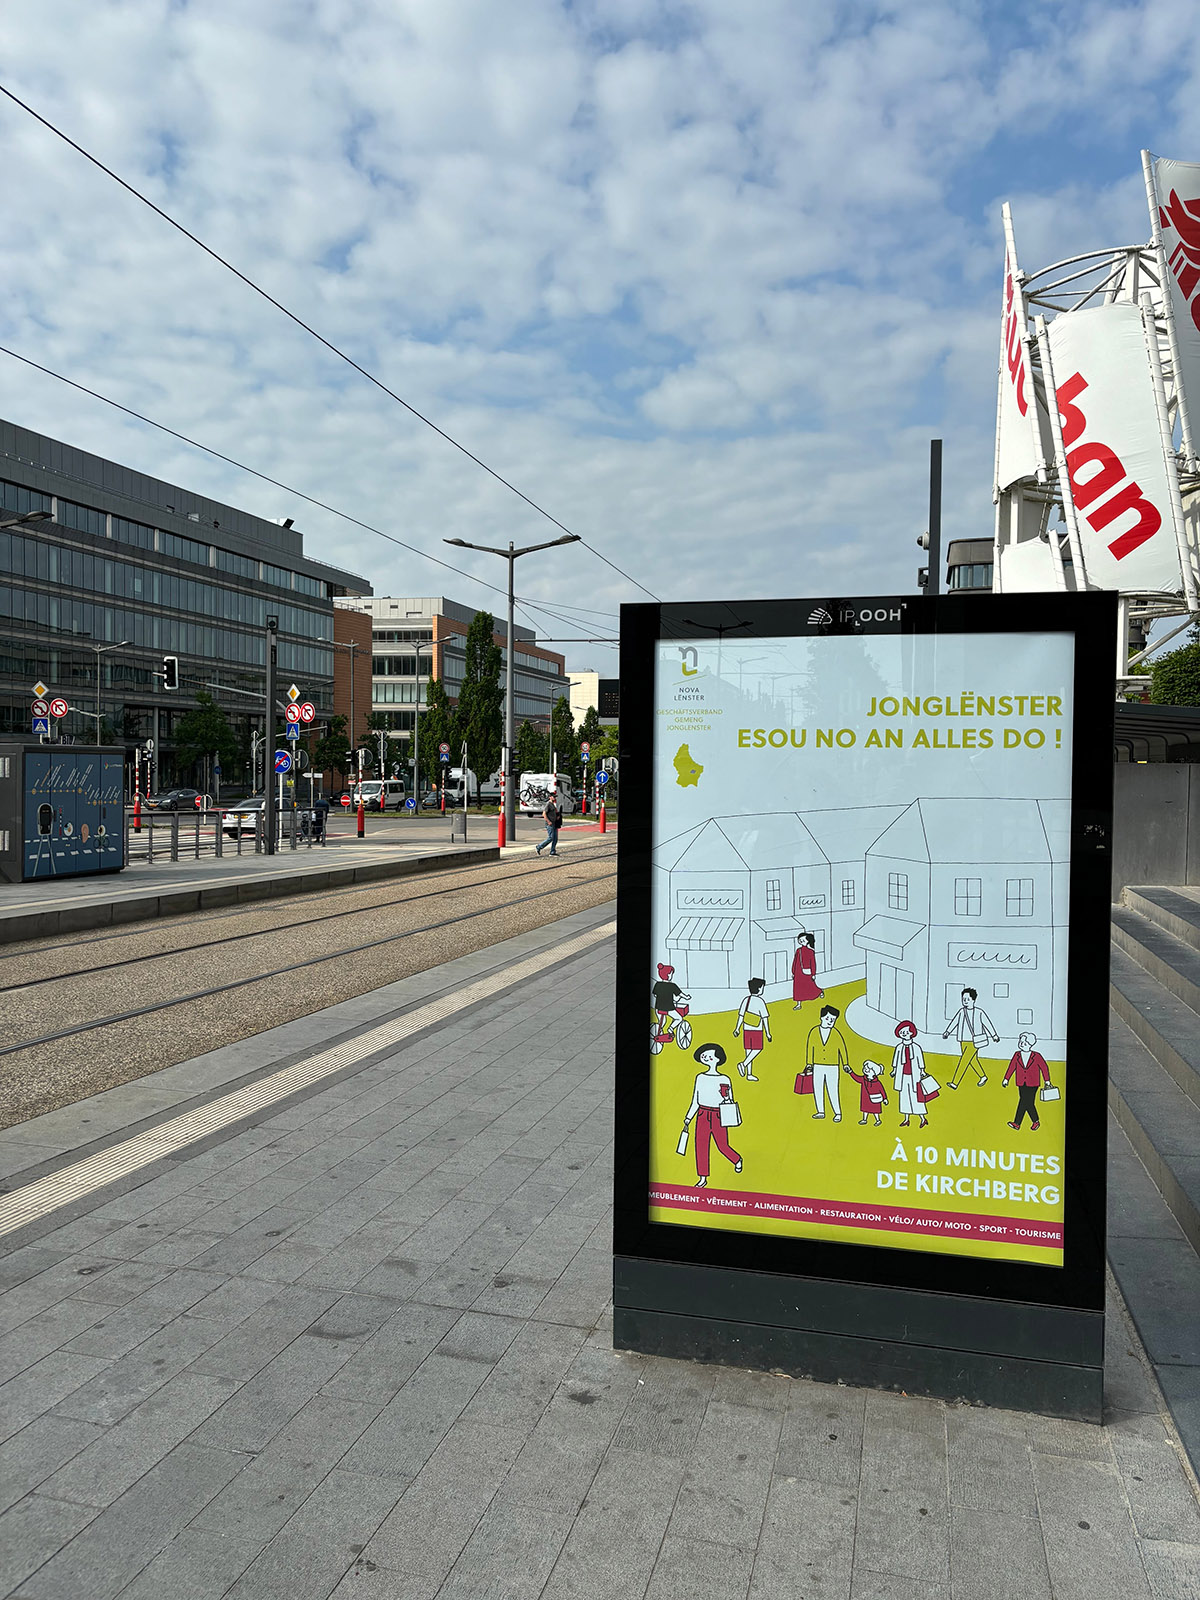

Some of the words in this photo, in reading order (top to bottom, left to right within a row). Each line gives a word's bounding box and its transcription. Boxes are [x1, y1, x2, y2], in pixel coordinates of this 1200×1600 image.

[678, 686, 700, 694] NOVA
[866, 690, 1064, 717] JONGLËNSTER
[737, 728, 807, 749] ESOU
[815, 728, 857, 749] NO
[864, 728, 904, 749] AN
[911, 728, 994, 749] ALLES
[1003, 728, 1047, 750] DO
[890, 1136, 908, 1163] À
[915, 1145, 939, 1165] 10
[945, 1147, 1061, 1176] MINUTES
[876, 1170, 908, 1191] DE
[915, 1173, 1060, 1206] KIRCHBERG
[706, 1196, 748, 1208] VÊTEMENT
[754, 1201, 813, 1215] ALIMENTATION
[820, 1208, 882, 1223] RESTAURATION
[944, 1220, 972, 1232] MOTO
[979, 1224, 1008, 1235] SPORT
[1014, 1227, 1062, 1241] TOURISME
